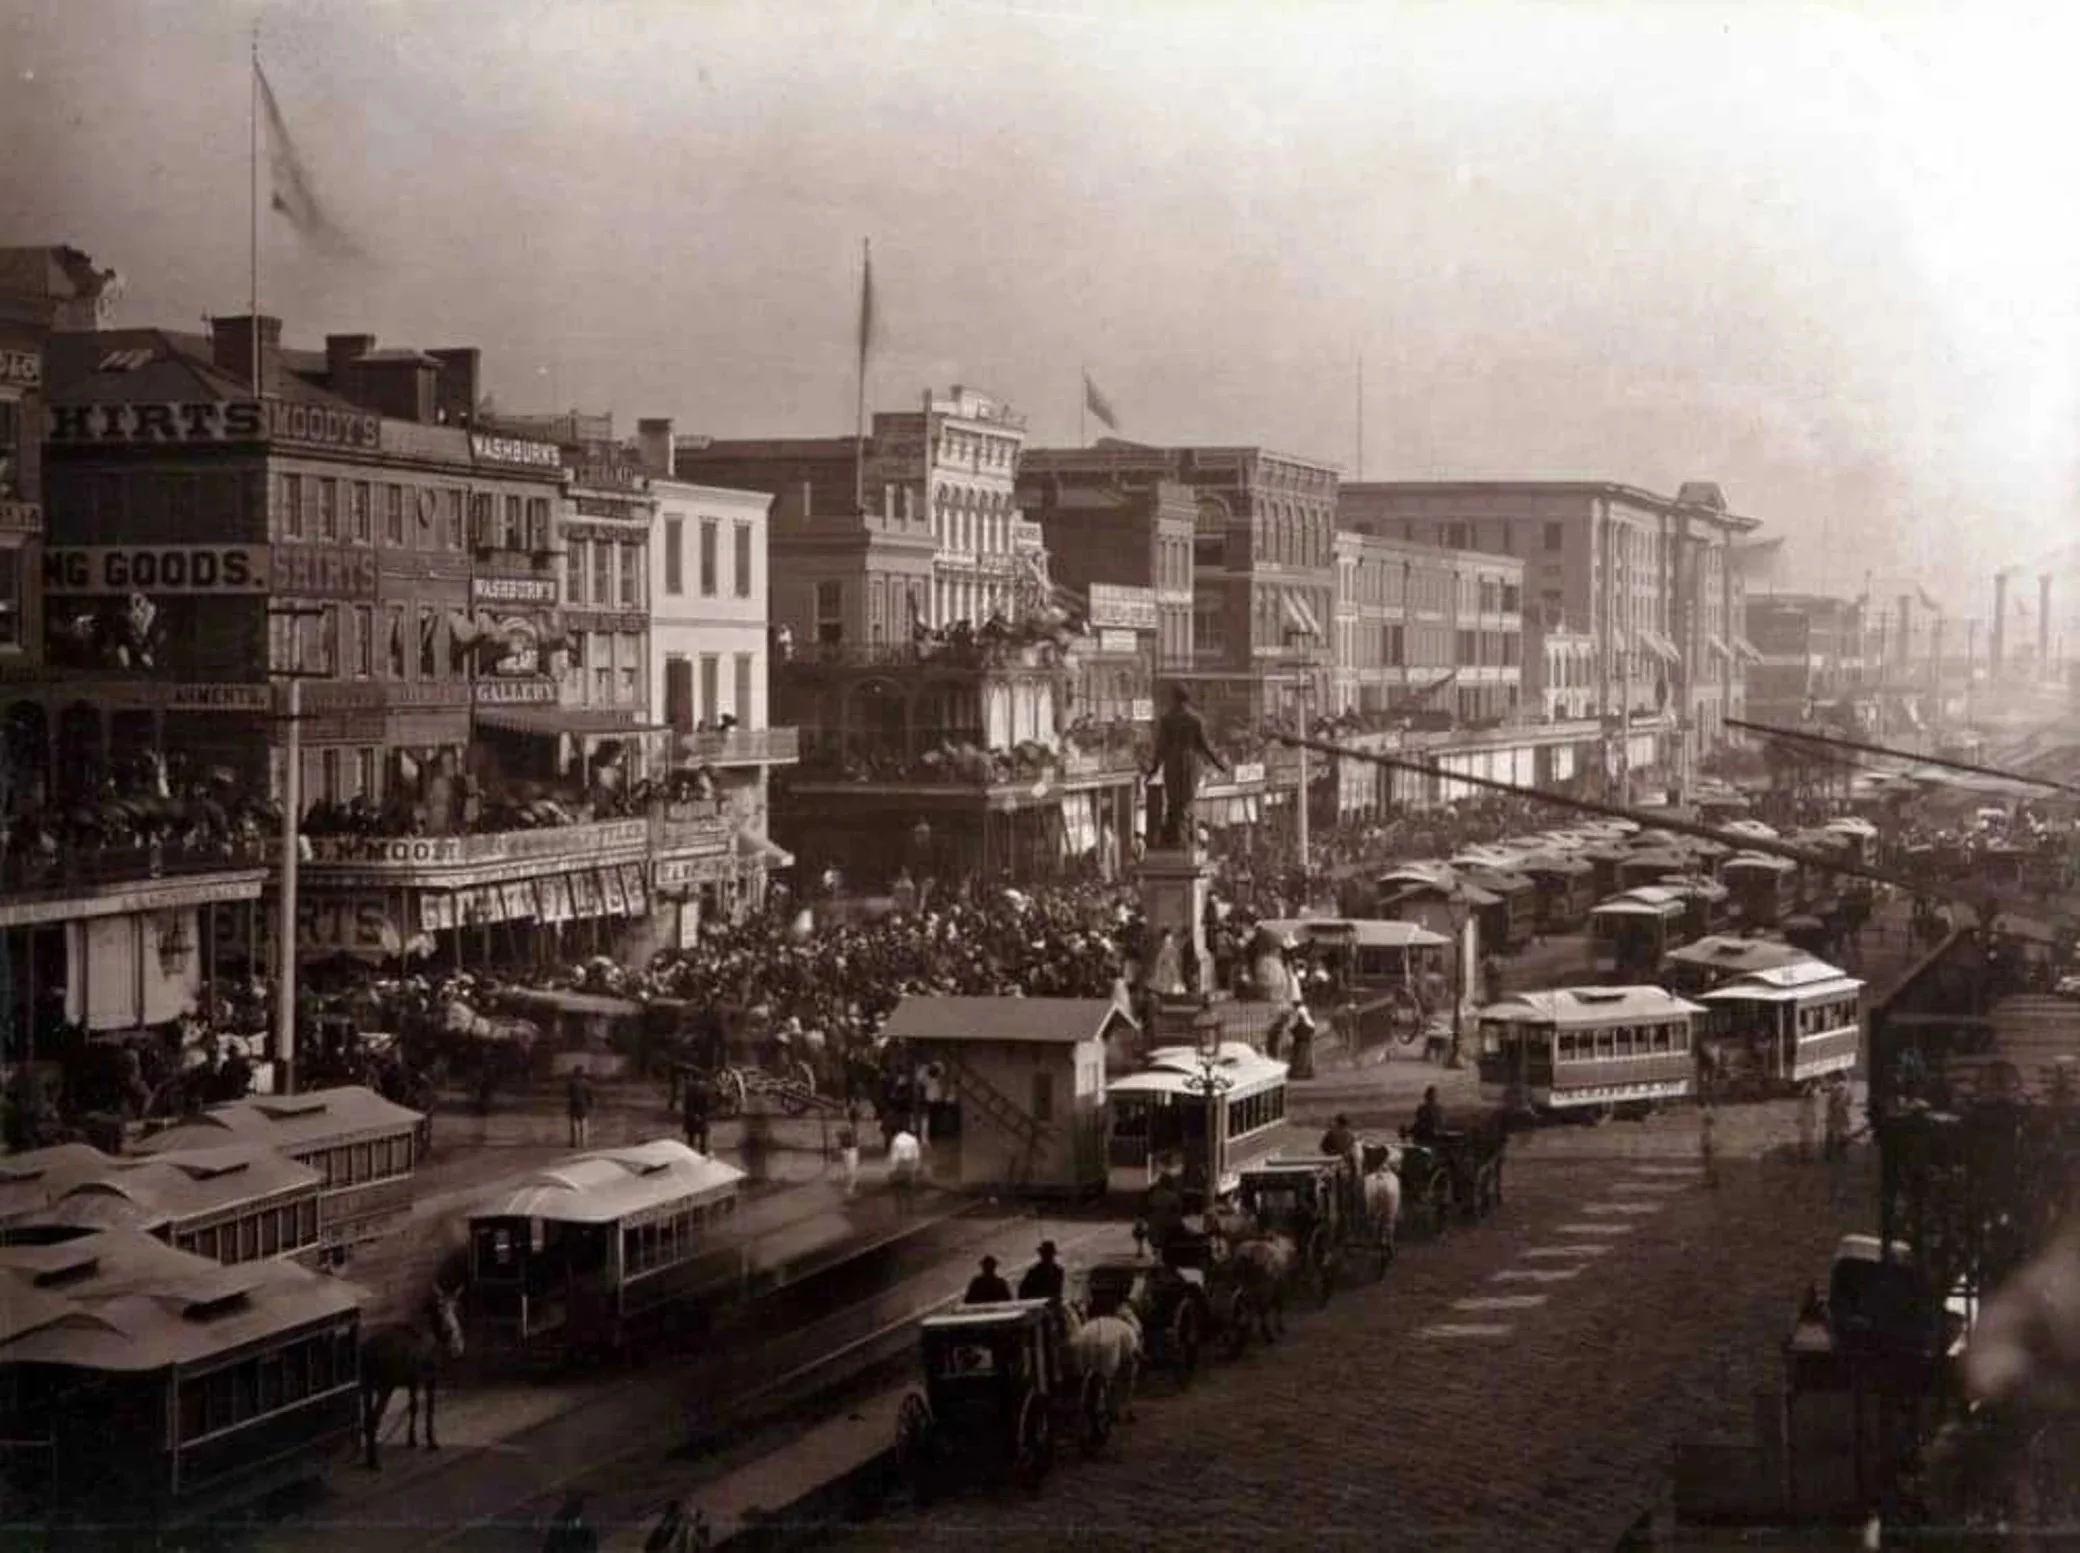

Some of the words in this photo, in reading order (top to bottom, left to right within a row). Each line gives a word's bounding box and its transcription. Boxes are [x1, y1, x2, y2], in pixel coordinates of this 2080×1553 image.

[271, 403, 380, 447] MOODY'S
[473, 434, 561, 467] WASHBURN'S
[105, 549, 265, 588] GOODS.
